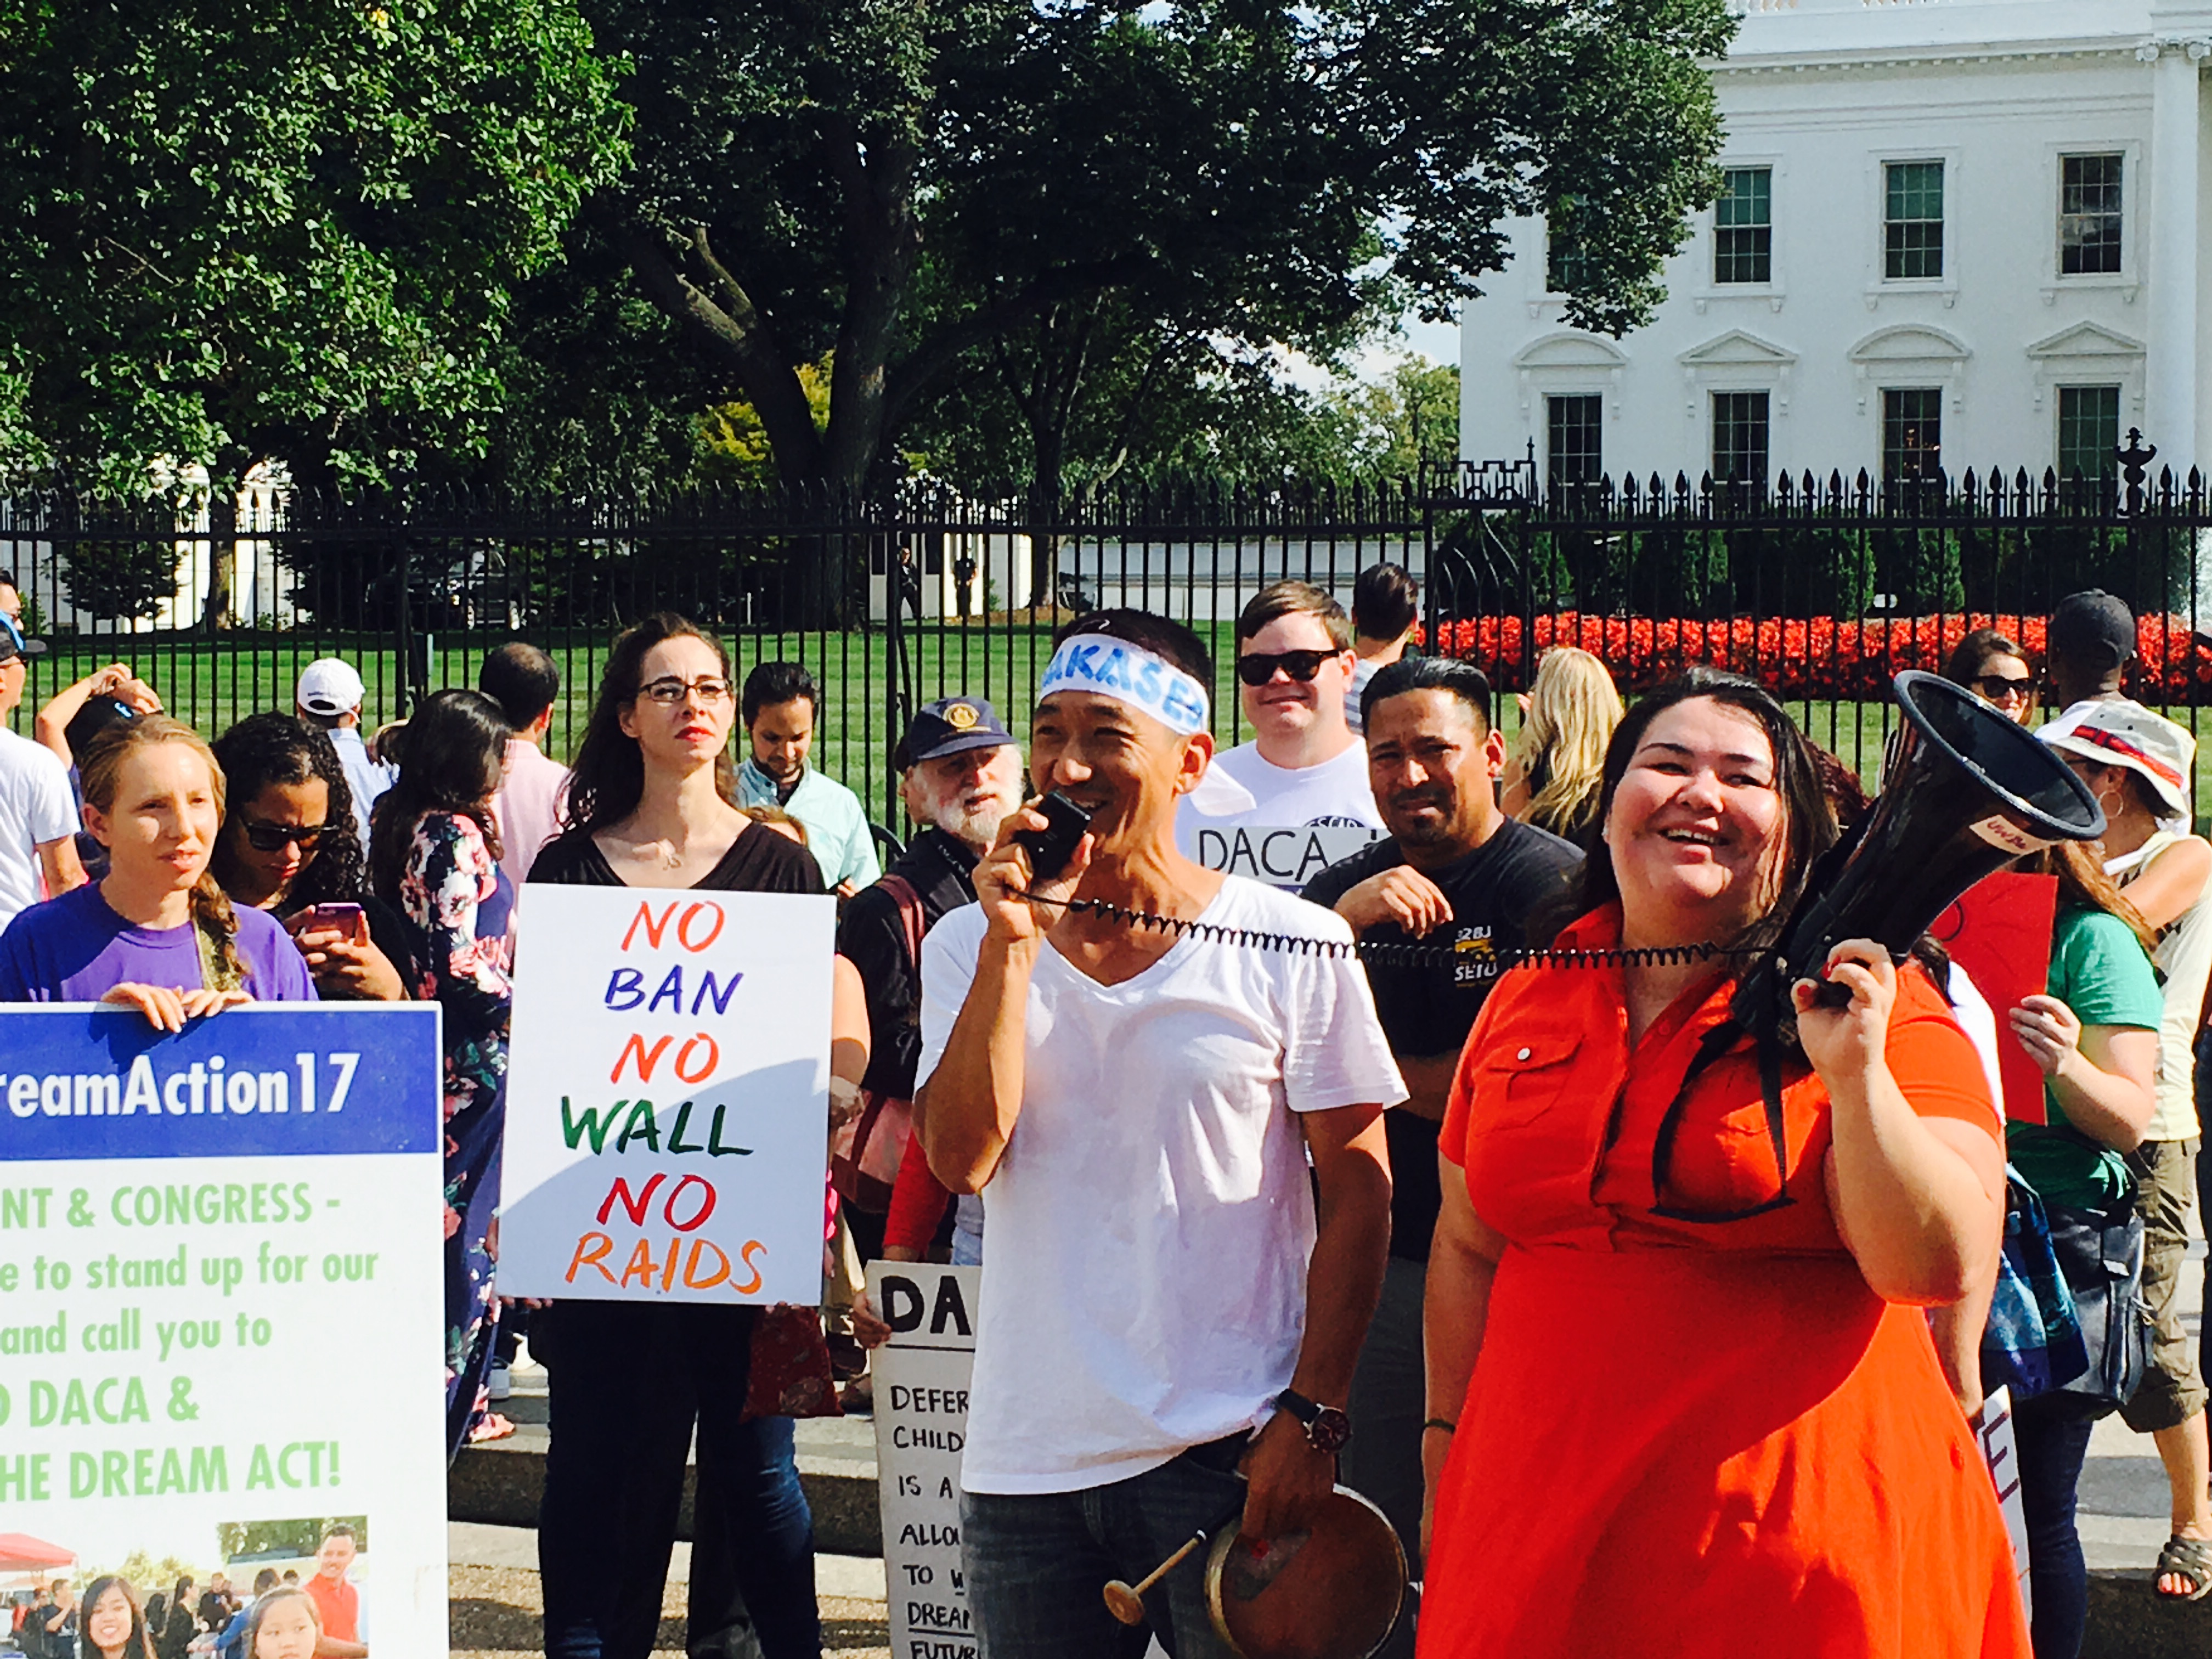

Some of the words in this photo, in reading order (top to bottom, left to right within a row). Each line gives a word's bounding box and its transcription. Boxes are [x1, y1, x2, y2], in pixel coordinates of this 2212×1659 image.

[1199, 827, 1329, 882] DACA
[621, 900, 725, 952] NO
[604, 964, 743, 1015] BAN
[1454, 963, 1497, 981] SEIU
[610, 1032, 720, 1084] NO
[561, 1096, 754, 1158] WALL
[2, 1188, 53, 1229] NT
[66, 1188, 95, 1228] &
[111, 1182, 312, 1227] CONGRESS
[596, 1173, 716, 1232] NO
[34, 1256, 71, 1290] to
[87, 1244, 187, 1289] stand
[202, 1256, 243, 1297] up
[258, 1242, 308, 1283] for
[323, 1253, 379, 1282] our
[565, 1232, 768, 1295] RAIDS
[0, 1310, 66, 1355] and
[82, 1308, 141, 1352] call
[156, 1320, 221, 1362] you
[236, 1313, 272, 1347] to
[30, 1376, 150, 1427] DACA
[167, 1375, 200, 1422] &
[890, 1385, 968, 1414] DEFER
[893, 1425, 963, 1452] CHILD
[70, 1445, 229, 1499] DREAM
[246, 1441, 341, 1491] ACT!
[899, 1475, 921, 1497] IS
[899, 1523, 960, 1547] ALLO
[902, 1565, 934, 1586] TO
[910, 1640, 983, 1659] FUTUR
